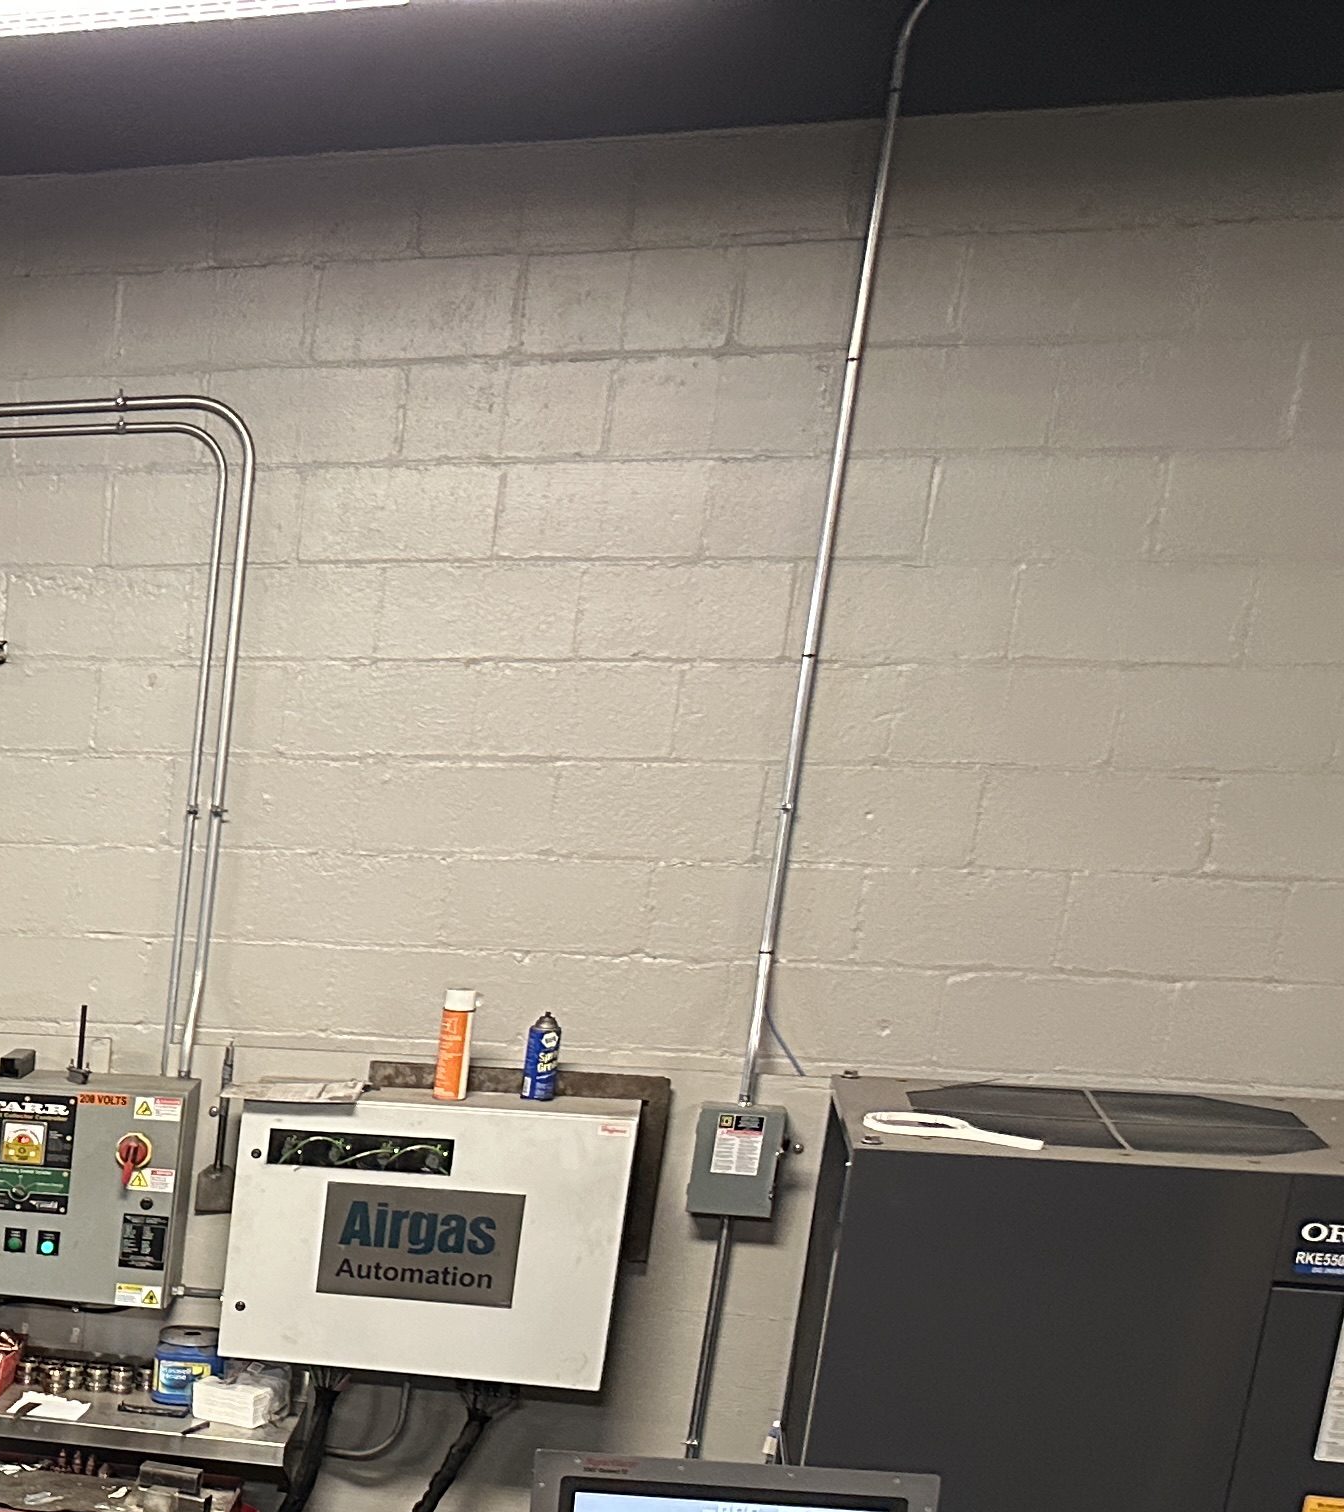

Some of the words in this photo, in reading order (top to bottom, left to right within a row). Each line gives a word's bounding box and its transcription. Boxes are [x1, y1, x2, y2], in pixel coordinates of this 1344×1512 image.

[97, 1095, 127, 1106] VOLTS
[339, 1201, 496, 1255] Airgas
[335, 1259, 492, 1289] Automation
